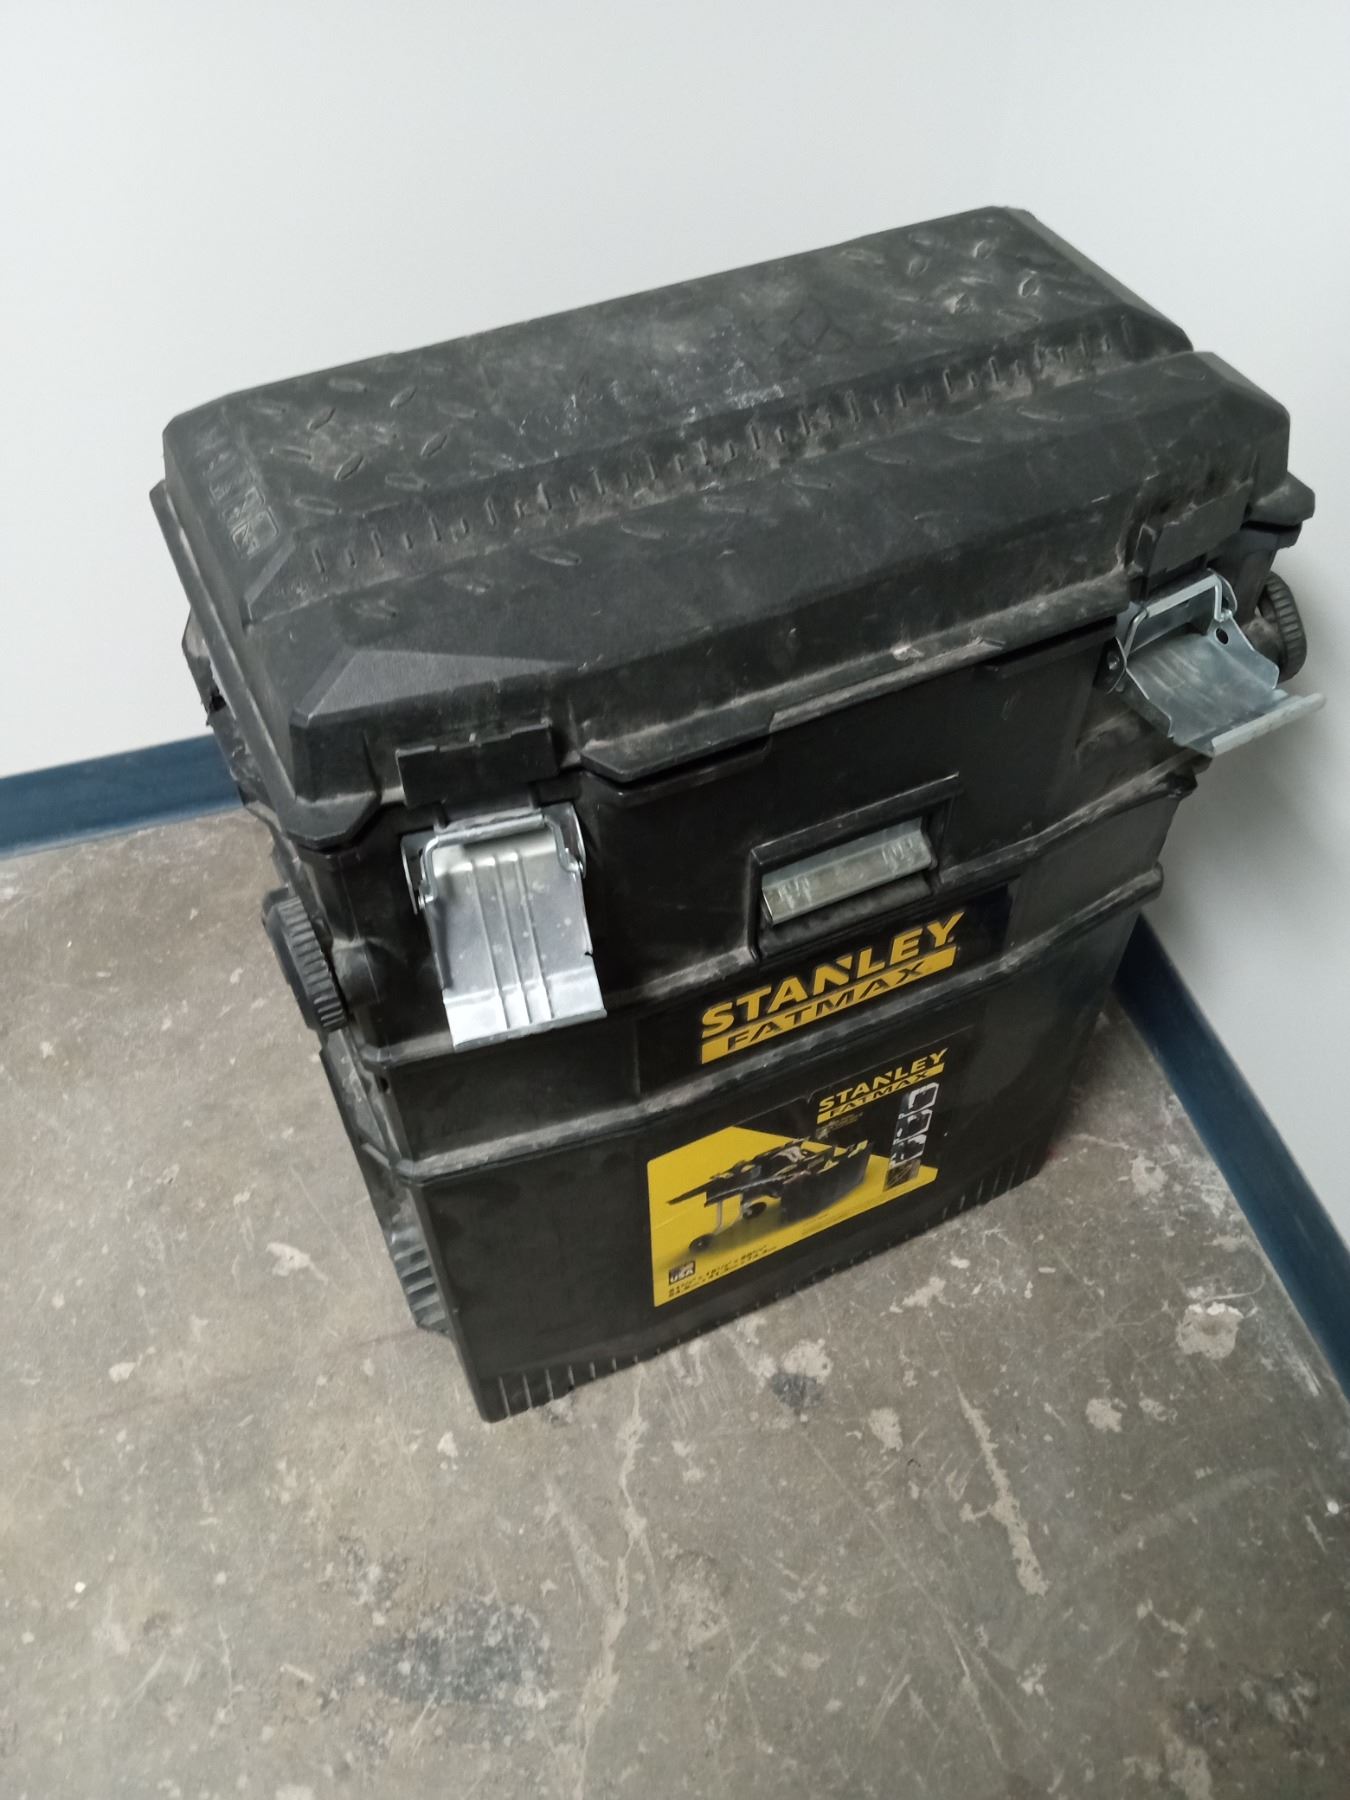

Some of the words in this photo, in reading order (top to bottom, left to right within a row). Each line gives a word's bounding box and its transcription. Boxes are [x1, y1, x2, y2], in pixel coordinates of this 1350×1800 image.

[701, 912, 965, 1038] STANLEY
[727, 960, 926, 1051] FATMAX
[818, 1048, 948, 1113] STANLEY
[829, 1071, 927, 1117] FATMAX
